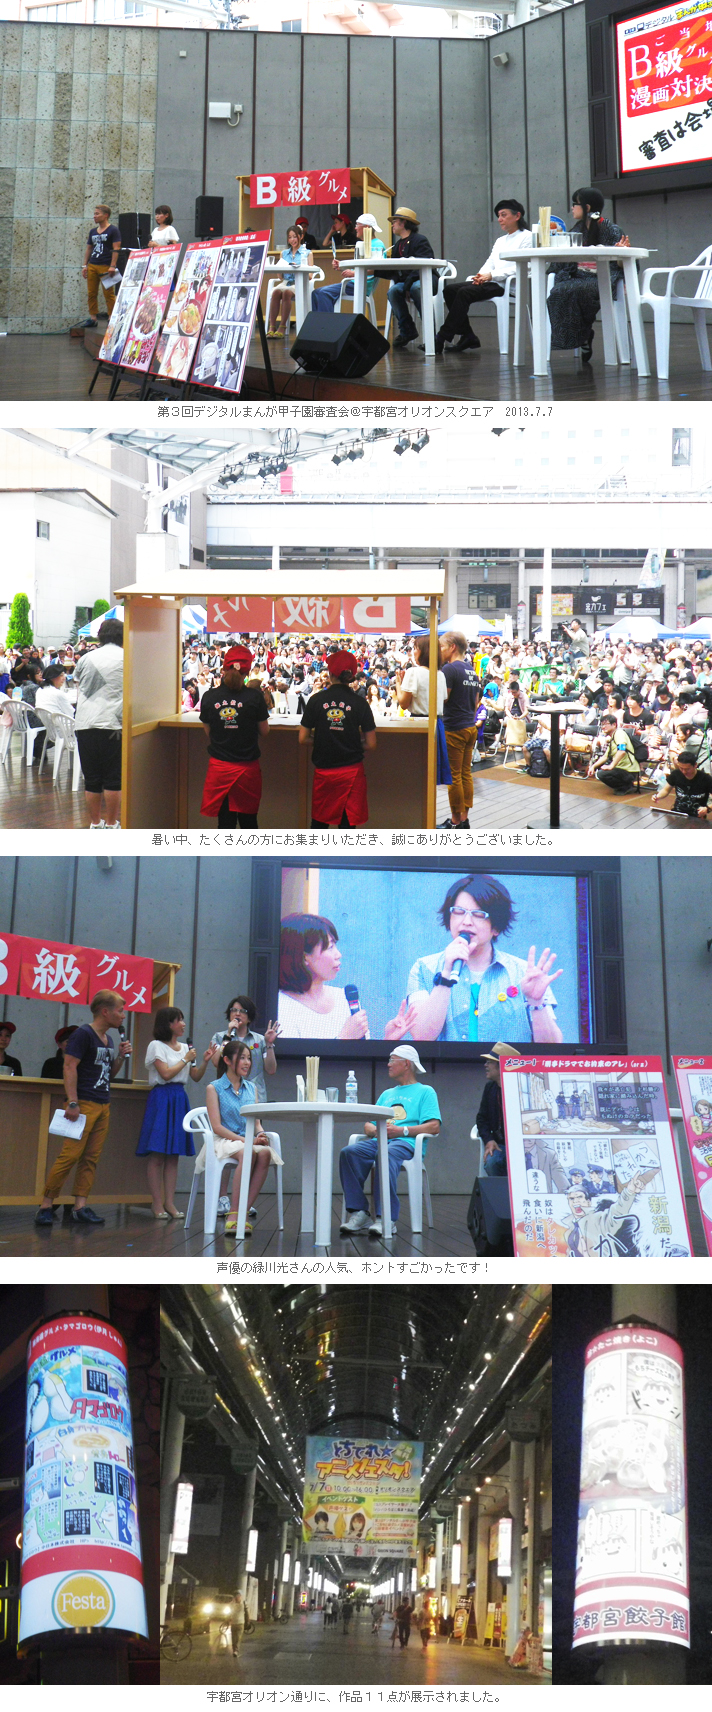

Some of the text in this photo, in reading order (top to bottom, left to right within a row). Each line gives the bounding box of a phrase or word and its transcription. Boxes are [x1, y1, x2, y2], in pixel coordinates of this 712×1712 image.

[628, 44, 712, 81] B級グル
[256, 171, 348, 205] B級グルメ
[544, 1199, 558, 1257] 奴はタレカツ
[61, 1591, 106, 1612] Festa
